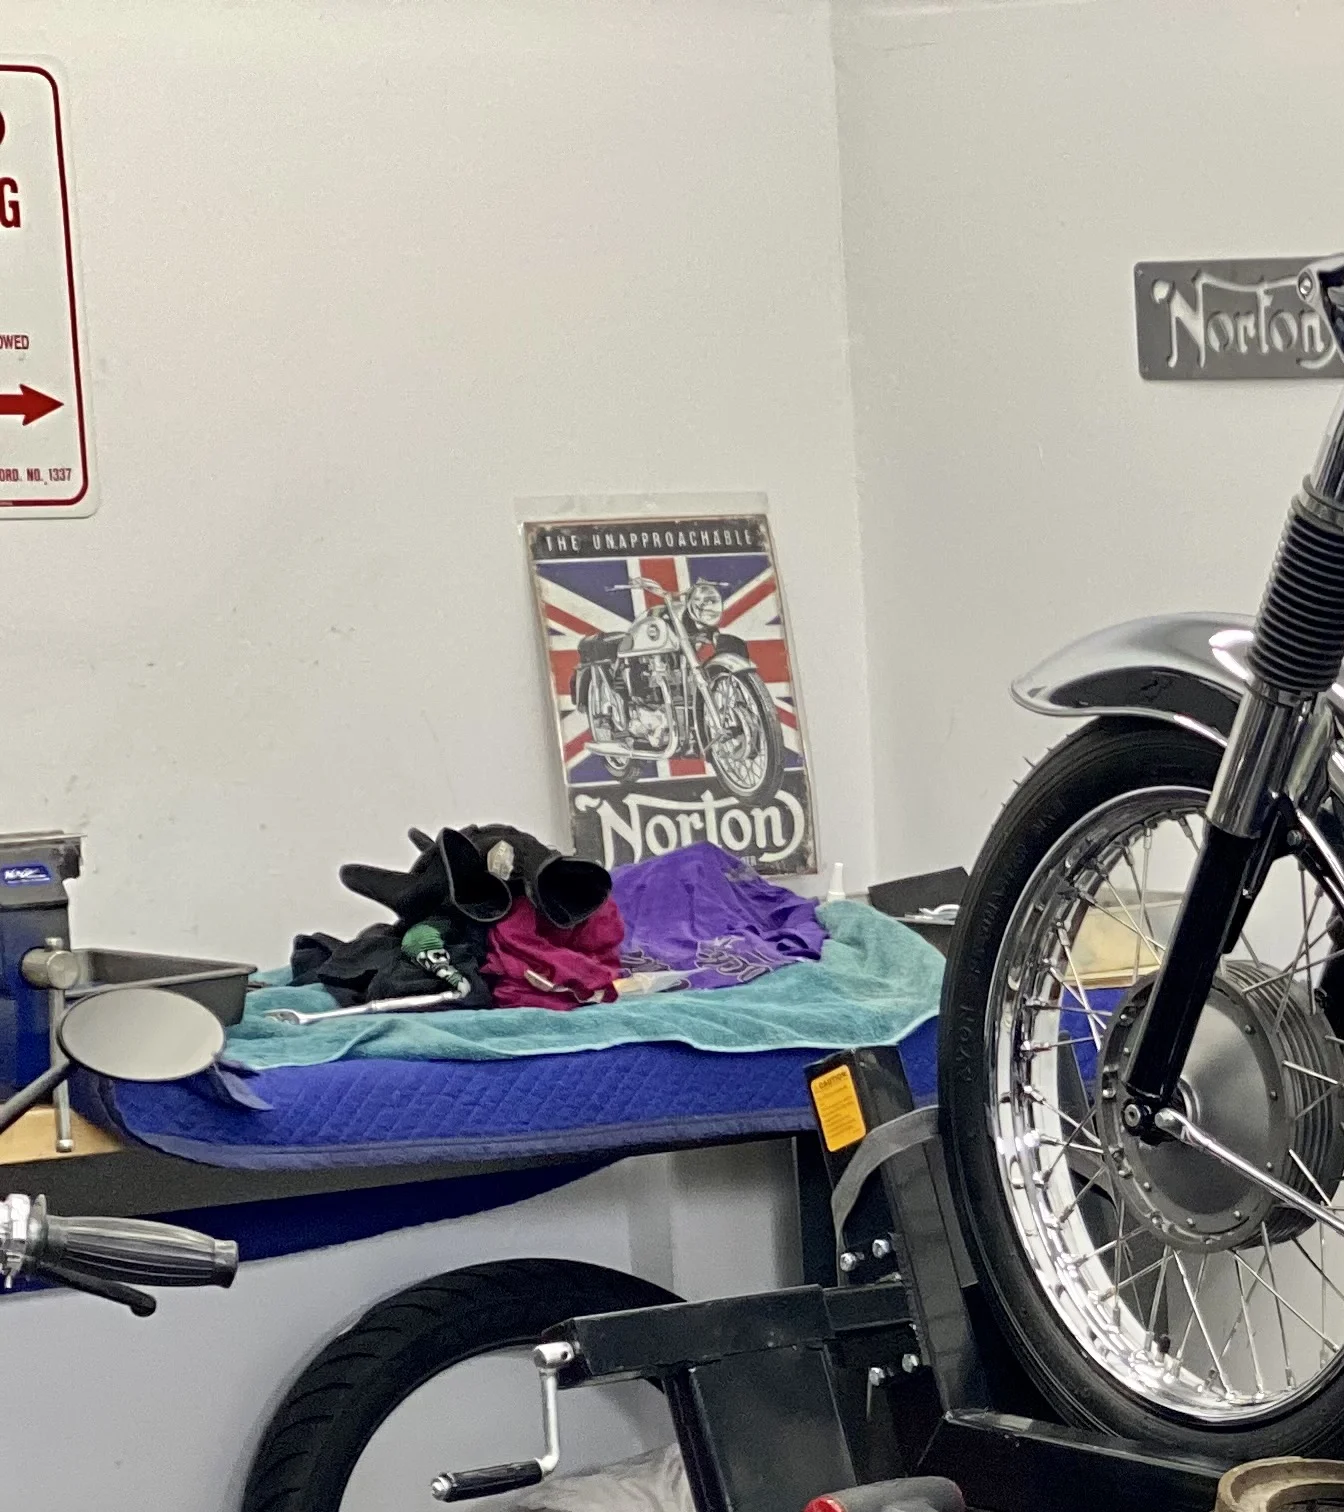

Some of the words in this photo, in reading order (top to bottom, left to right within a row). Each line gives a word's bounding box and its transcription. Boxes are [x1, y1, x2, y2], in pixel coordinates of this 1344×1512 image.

[1153, 269, 1337, 369] Norton
[546, 534, 579, 552] THE
[593, 529, 752, 551] UNAPPROACHABLE
[574, 789, 805, 872] Norton
